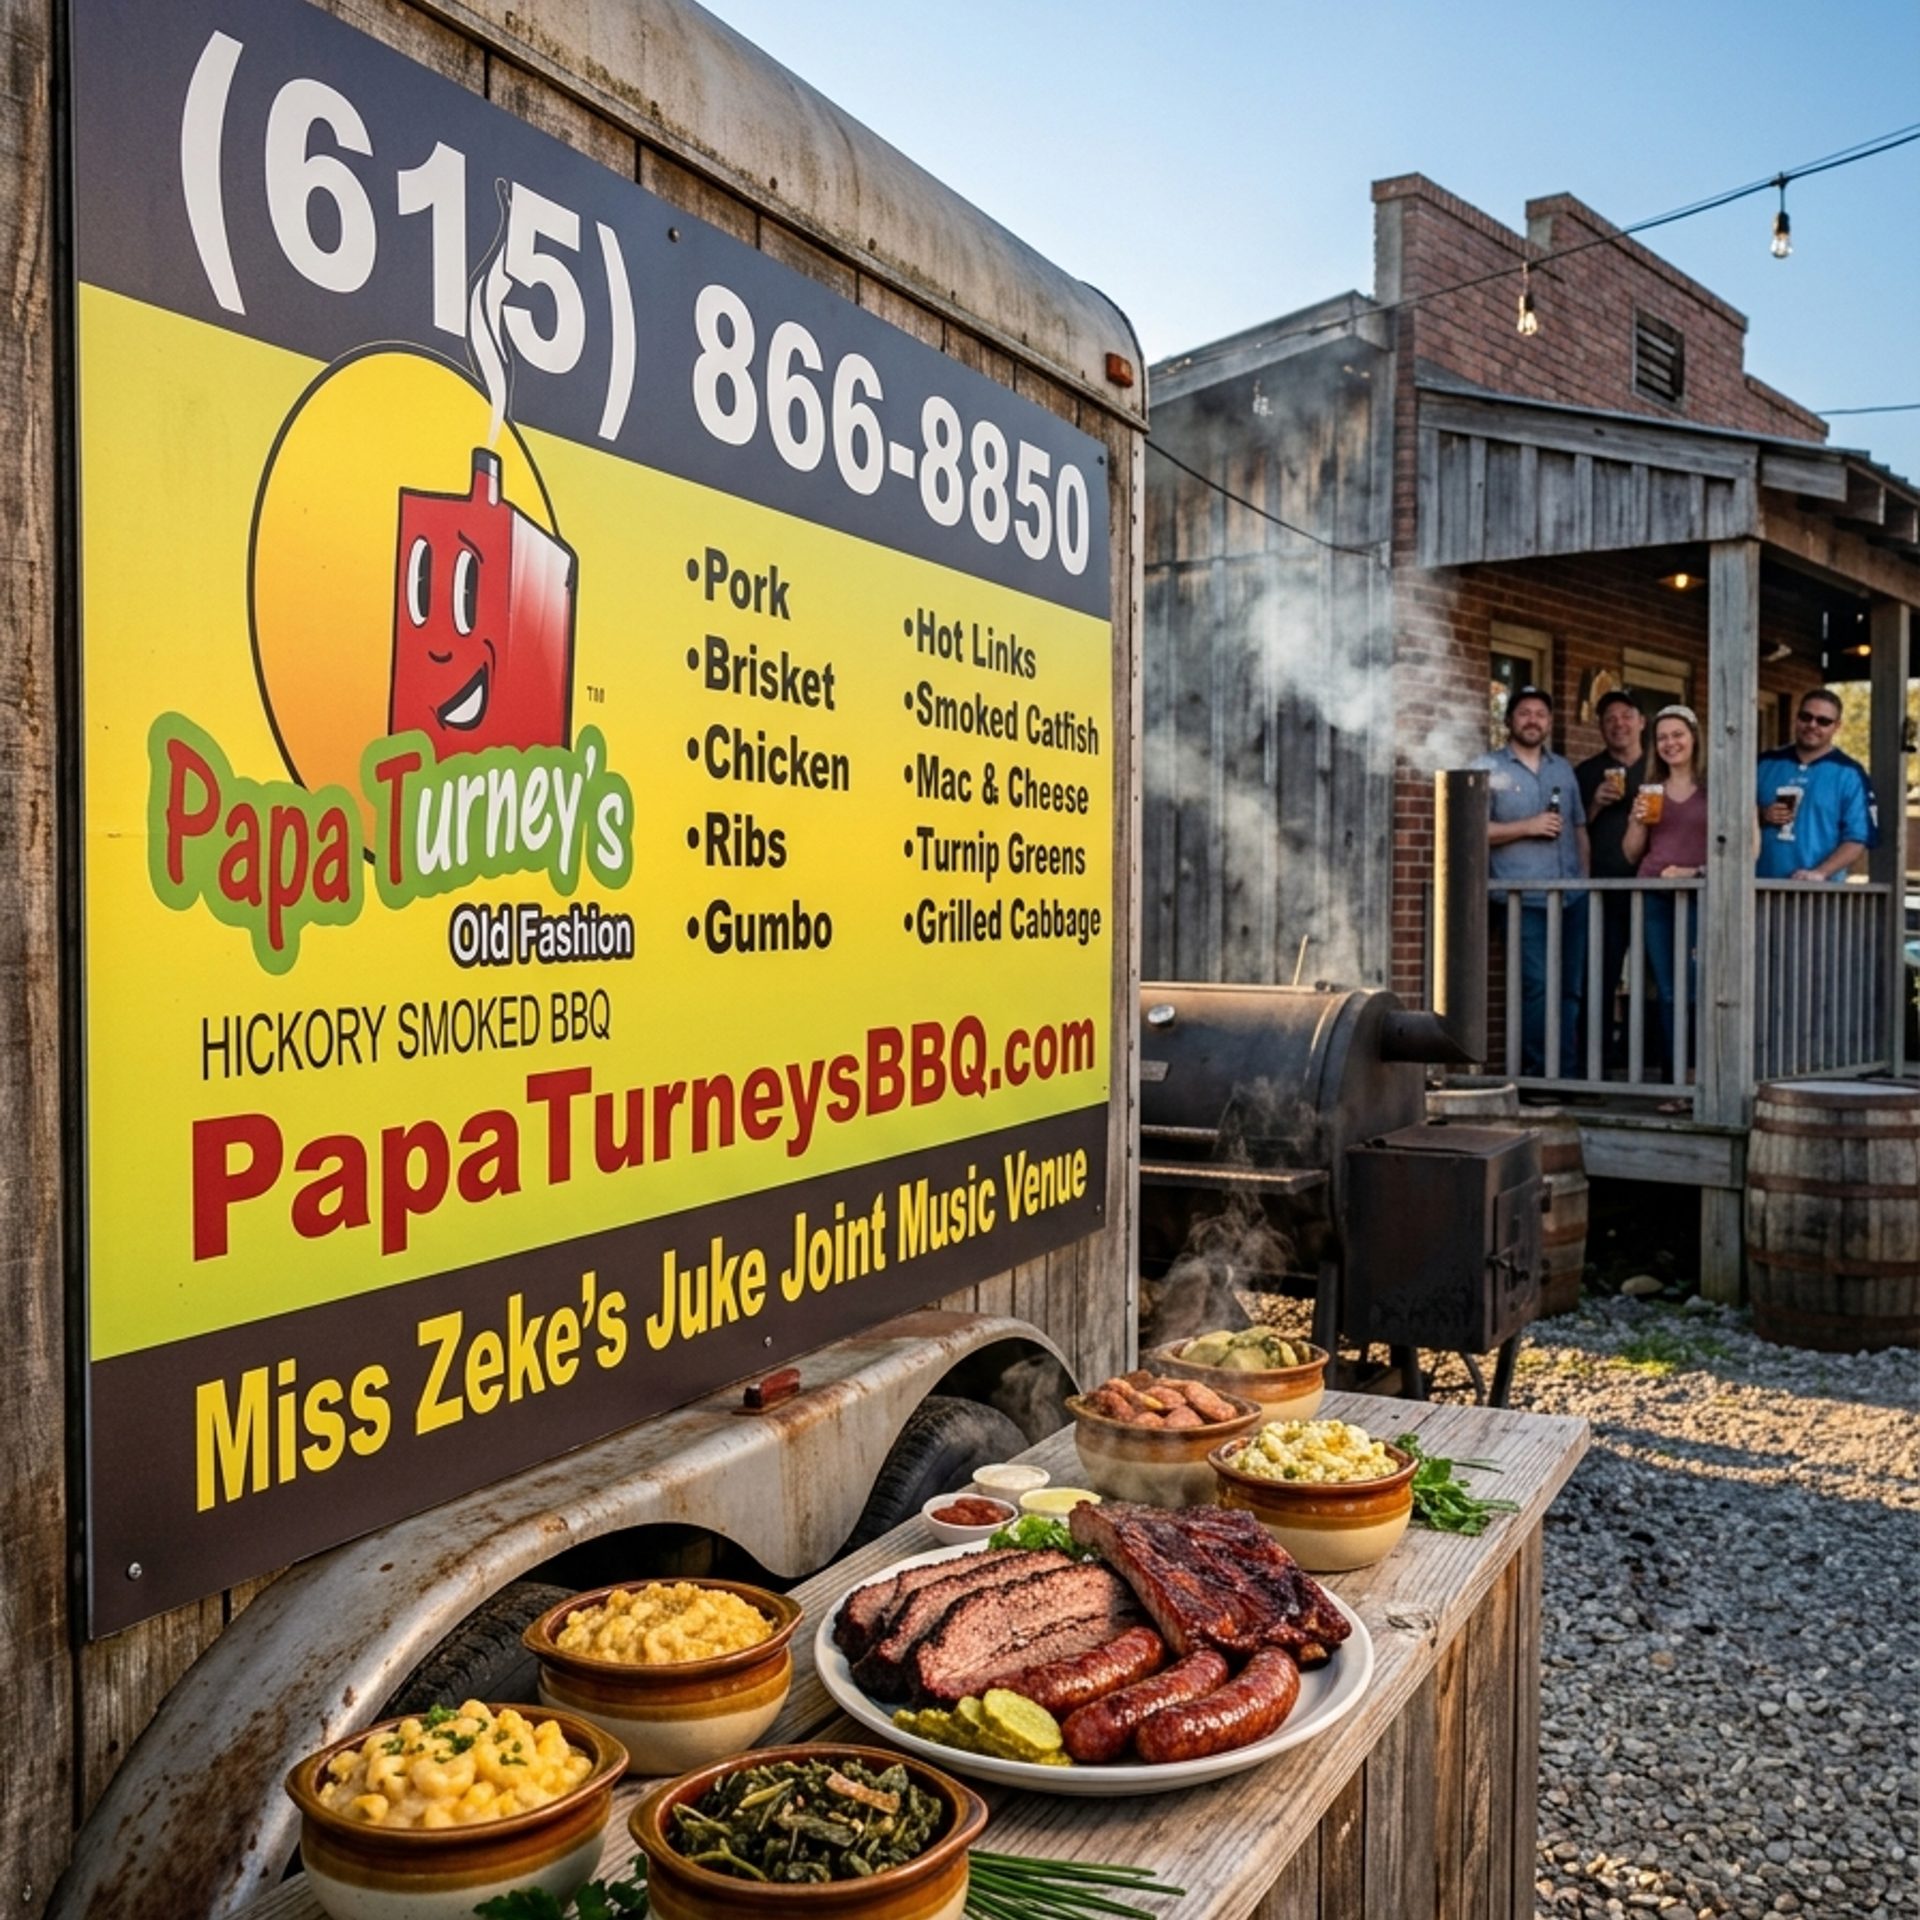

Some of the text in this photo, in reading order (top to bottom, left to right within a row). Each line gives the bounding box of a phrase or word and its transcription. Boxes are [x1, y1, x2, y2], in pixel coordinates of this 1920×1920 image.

[181, 29, 1090, 576] (615) 866-8850
[705, 546, 790, 620] Pork
[705, 634, 835, 711] Brisket
[917, 607, 1036, 680] Hot Links
[916, 680, 1099, 756] Smoked Catfish
[704, 723, 849, 792] Chicken
[916, 752, 1089, 815] Mac & Cheese
[166, 739, 624, 951] Papa Turney's
[705, 811, 787, 869] Ribs
[916, 826, 1086, 884] Turnip Greens
[453, 910, 631, 961] Old Fashion
[704, 899, 833, 955] Gumbo
[916, 897, 1102, 947] Grilled Cabbage
[202, 988, 611, 1081] HICKORY SMOKED BBQ
[192, 1015, 1095, 1262] PapaTurneysBBQ.com
[196, 1148, 1087, 1512] Miss Zeke's Juke Joint Music Venue
